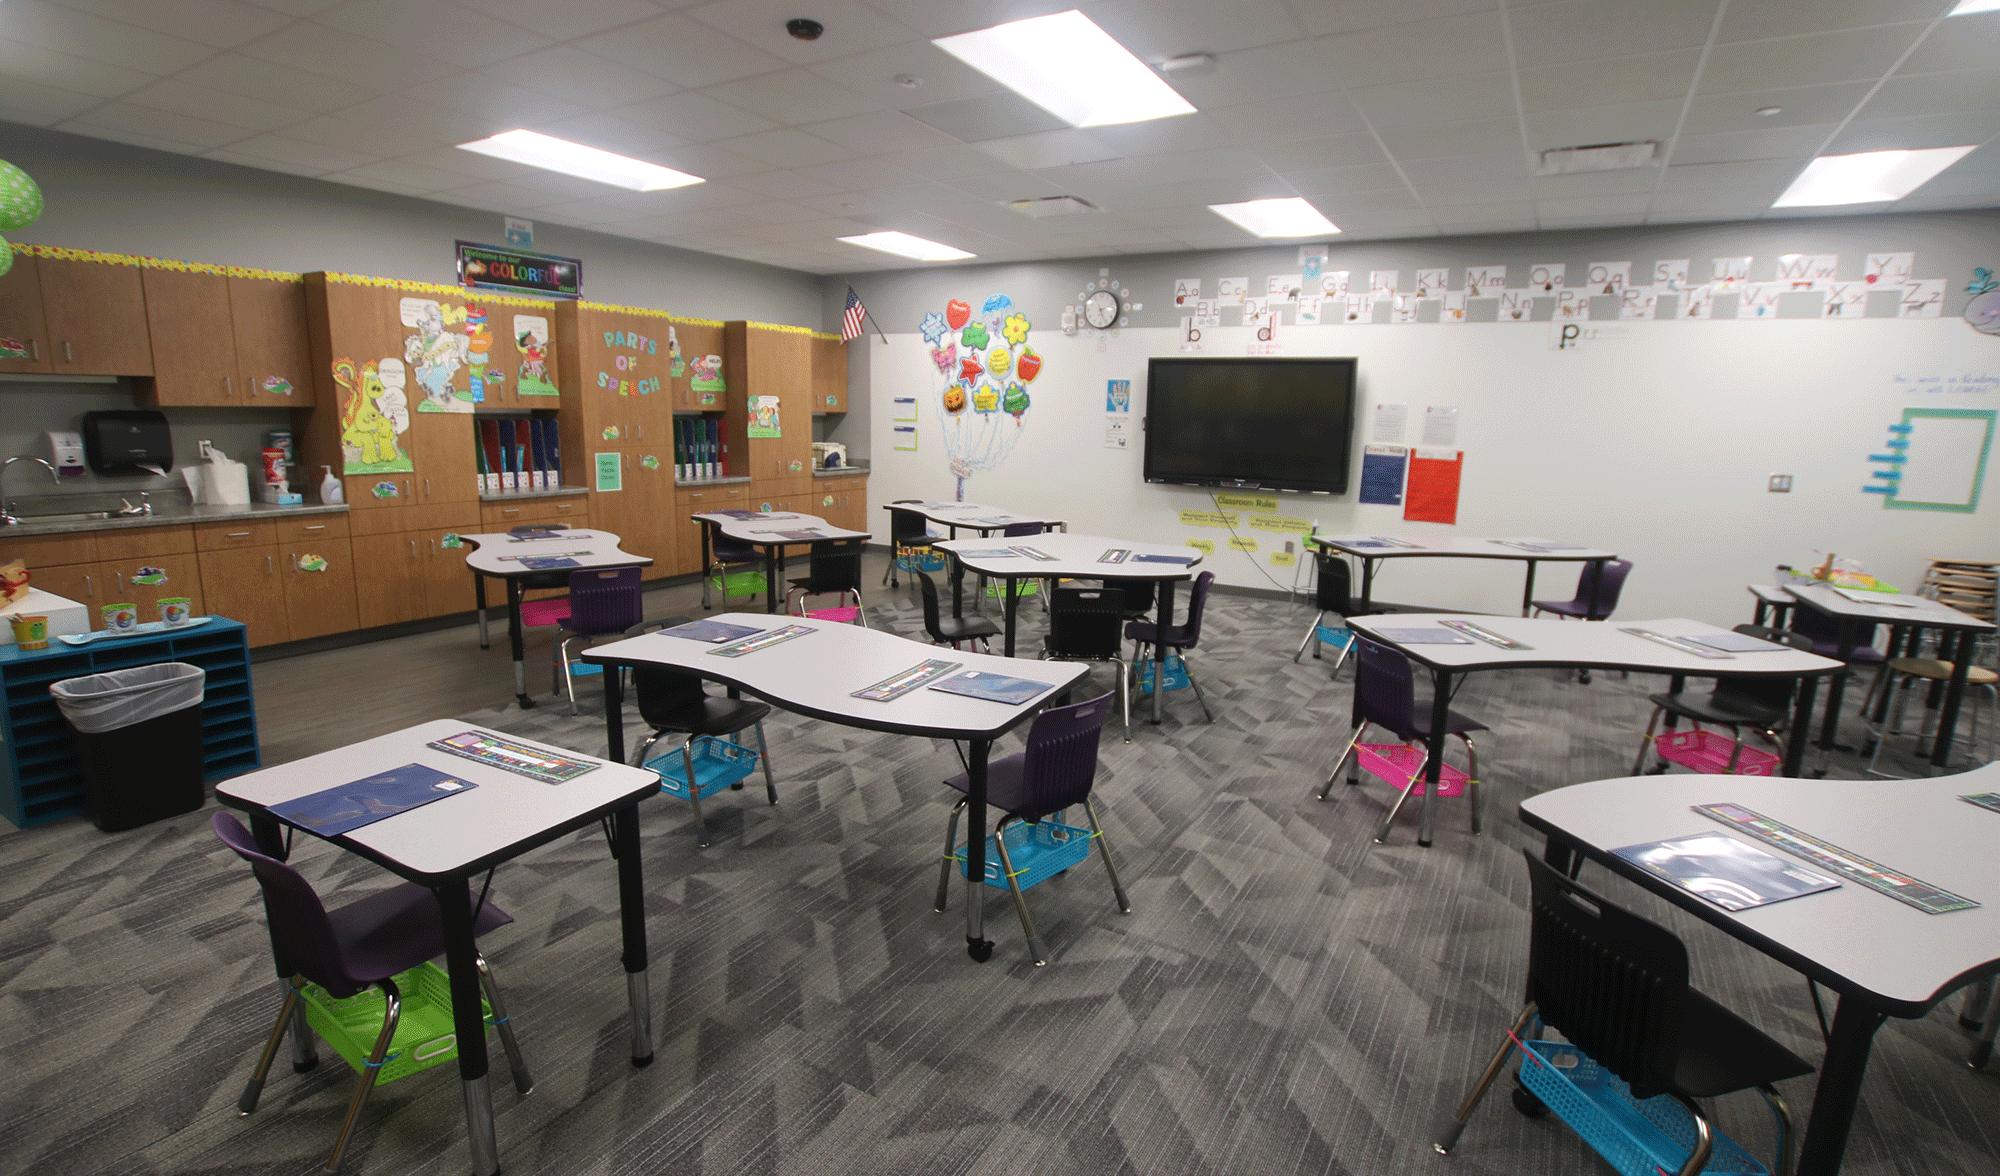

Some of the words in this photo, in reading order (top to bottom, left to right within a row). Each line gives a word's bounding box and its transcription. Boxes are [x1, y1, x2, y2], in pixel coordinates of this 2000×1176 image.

[464, 249, 498, 261] Welcome
[489, 261, 561, 285] COLORFUL
[1187, 317, 1201, 342] b
[1257, 316, 1272, 342] d
[603, 331, 657, 355] PARTS
[615, 355, 637, 371] OF
[597, 371, 661, 397] SPEECH
[1217, 495, 1254, 506] Classroom
[1256, 497, 1277, 508] Rules
